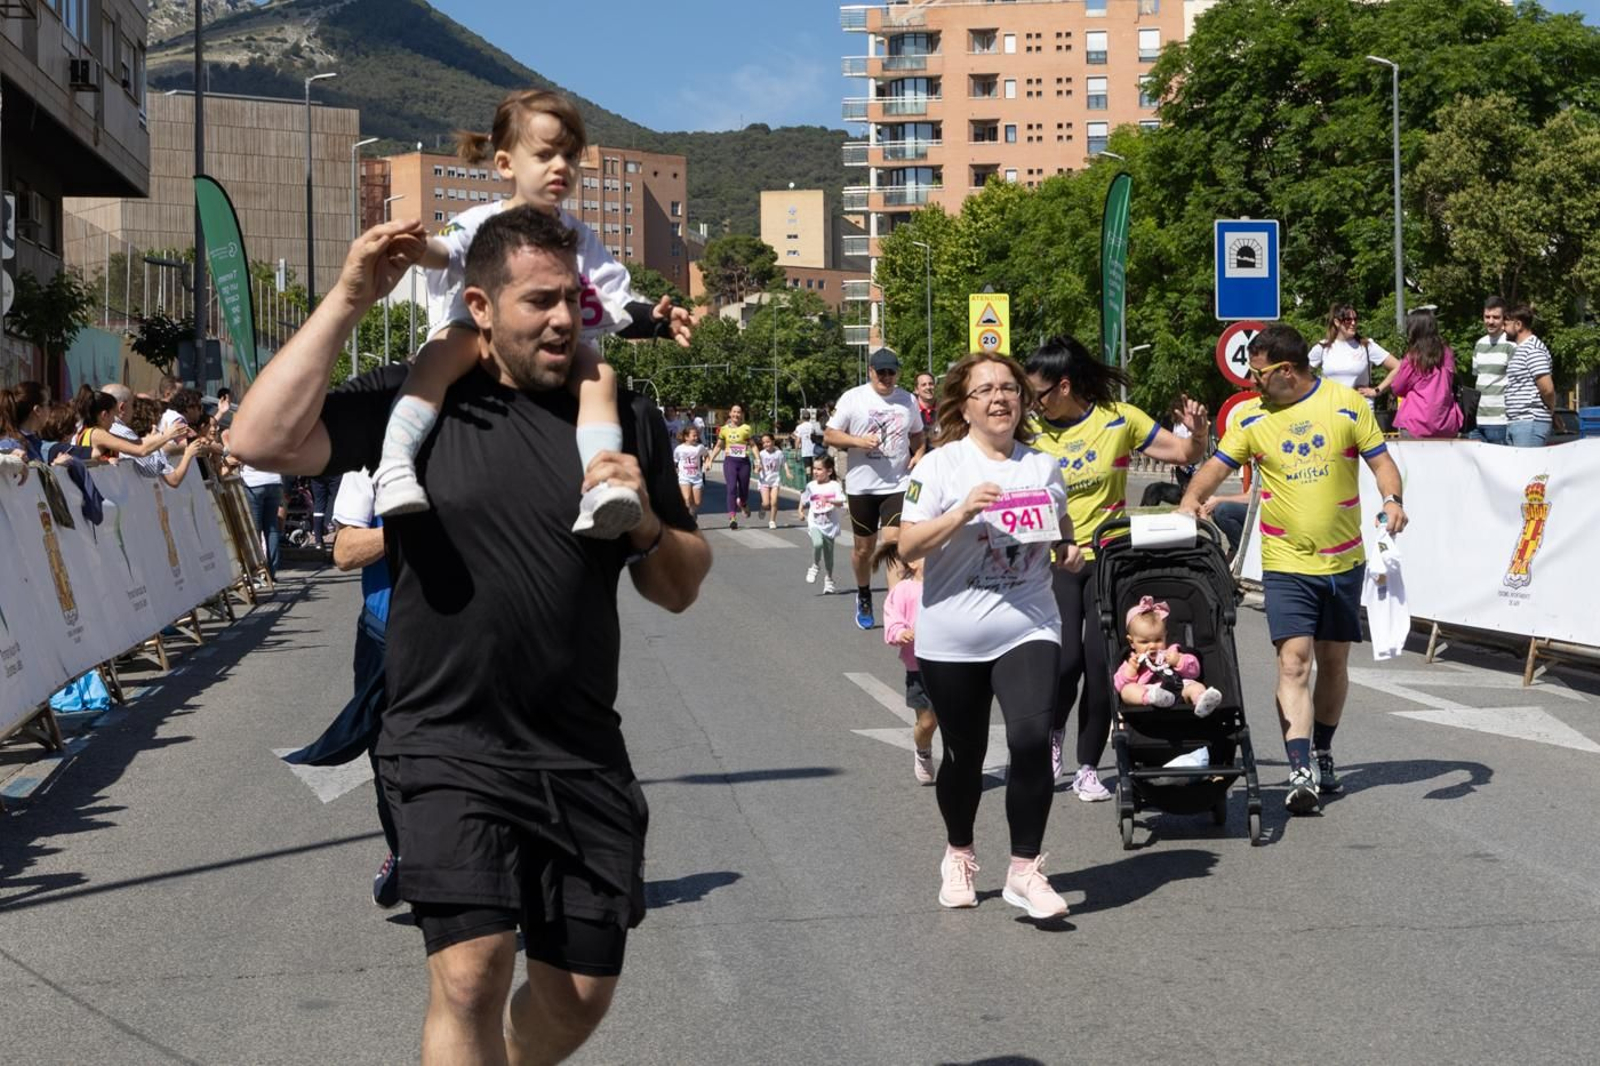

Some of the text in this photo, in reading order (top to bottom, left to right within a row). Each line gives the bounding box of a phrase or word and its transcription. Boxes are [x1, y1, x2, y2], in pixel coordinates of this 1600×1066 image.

[580, 288, 603, 326] 5
[983, 336, 997, 345] 20
[1231, 344, 1248, 366] 4
[1001, 507, 1043, 533] 941
